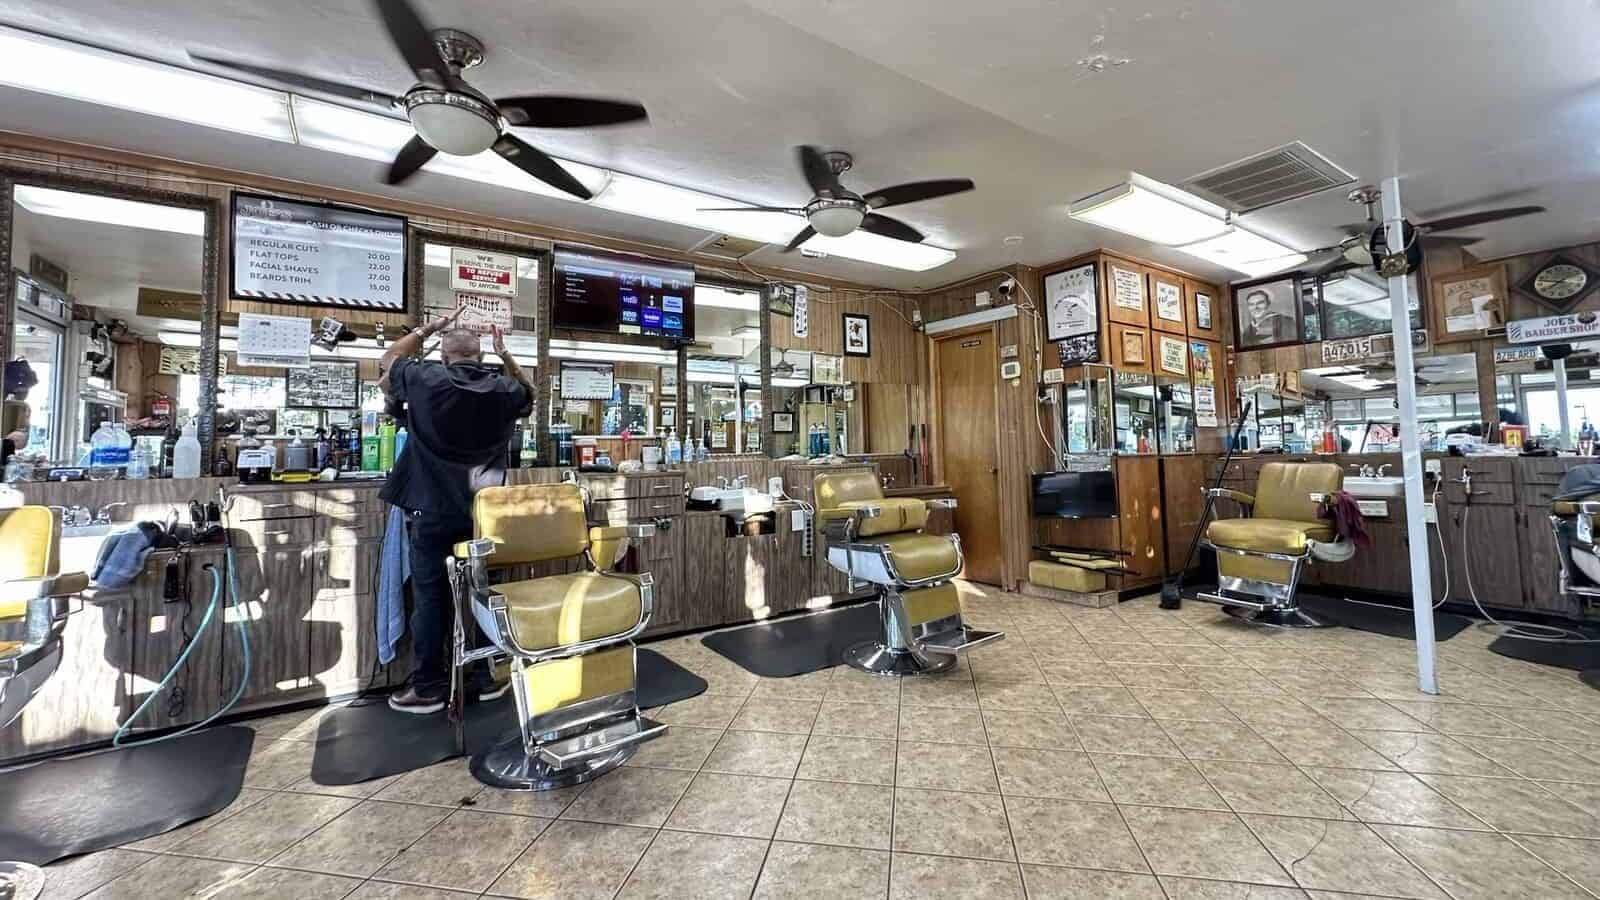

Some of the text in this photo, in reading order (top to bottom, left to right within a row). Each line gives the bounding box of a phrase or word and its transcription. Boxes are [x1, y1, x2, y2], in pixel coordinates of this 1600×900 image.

[250, 239, 319, 253] REGULAR CUTS
[250, 250, 299, 261] FLAT TOPS
[250, 261, 319, 274] FACIAL SHAVES
[368, 262, 390, 271] 22.00
[250, 272, 312, 284] BEARDS TRIM
[369, 283, 390, 292] 15.00
